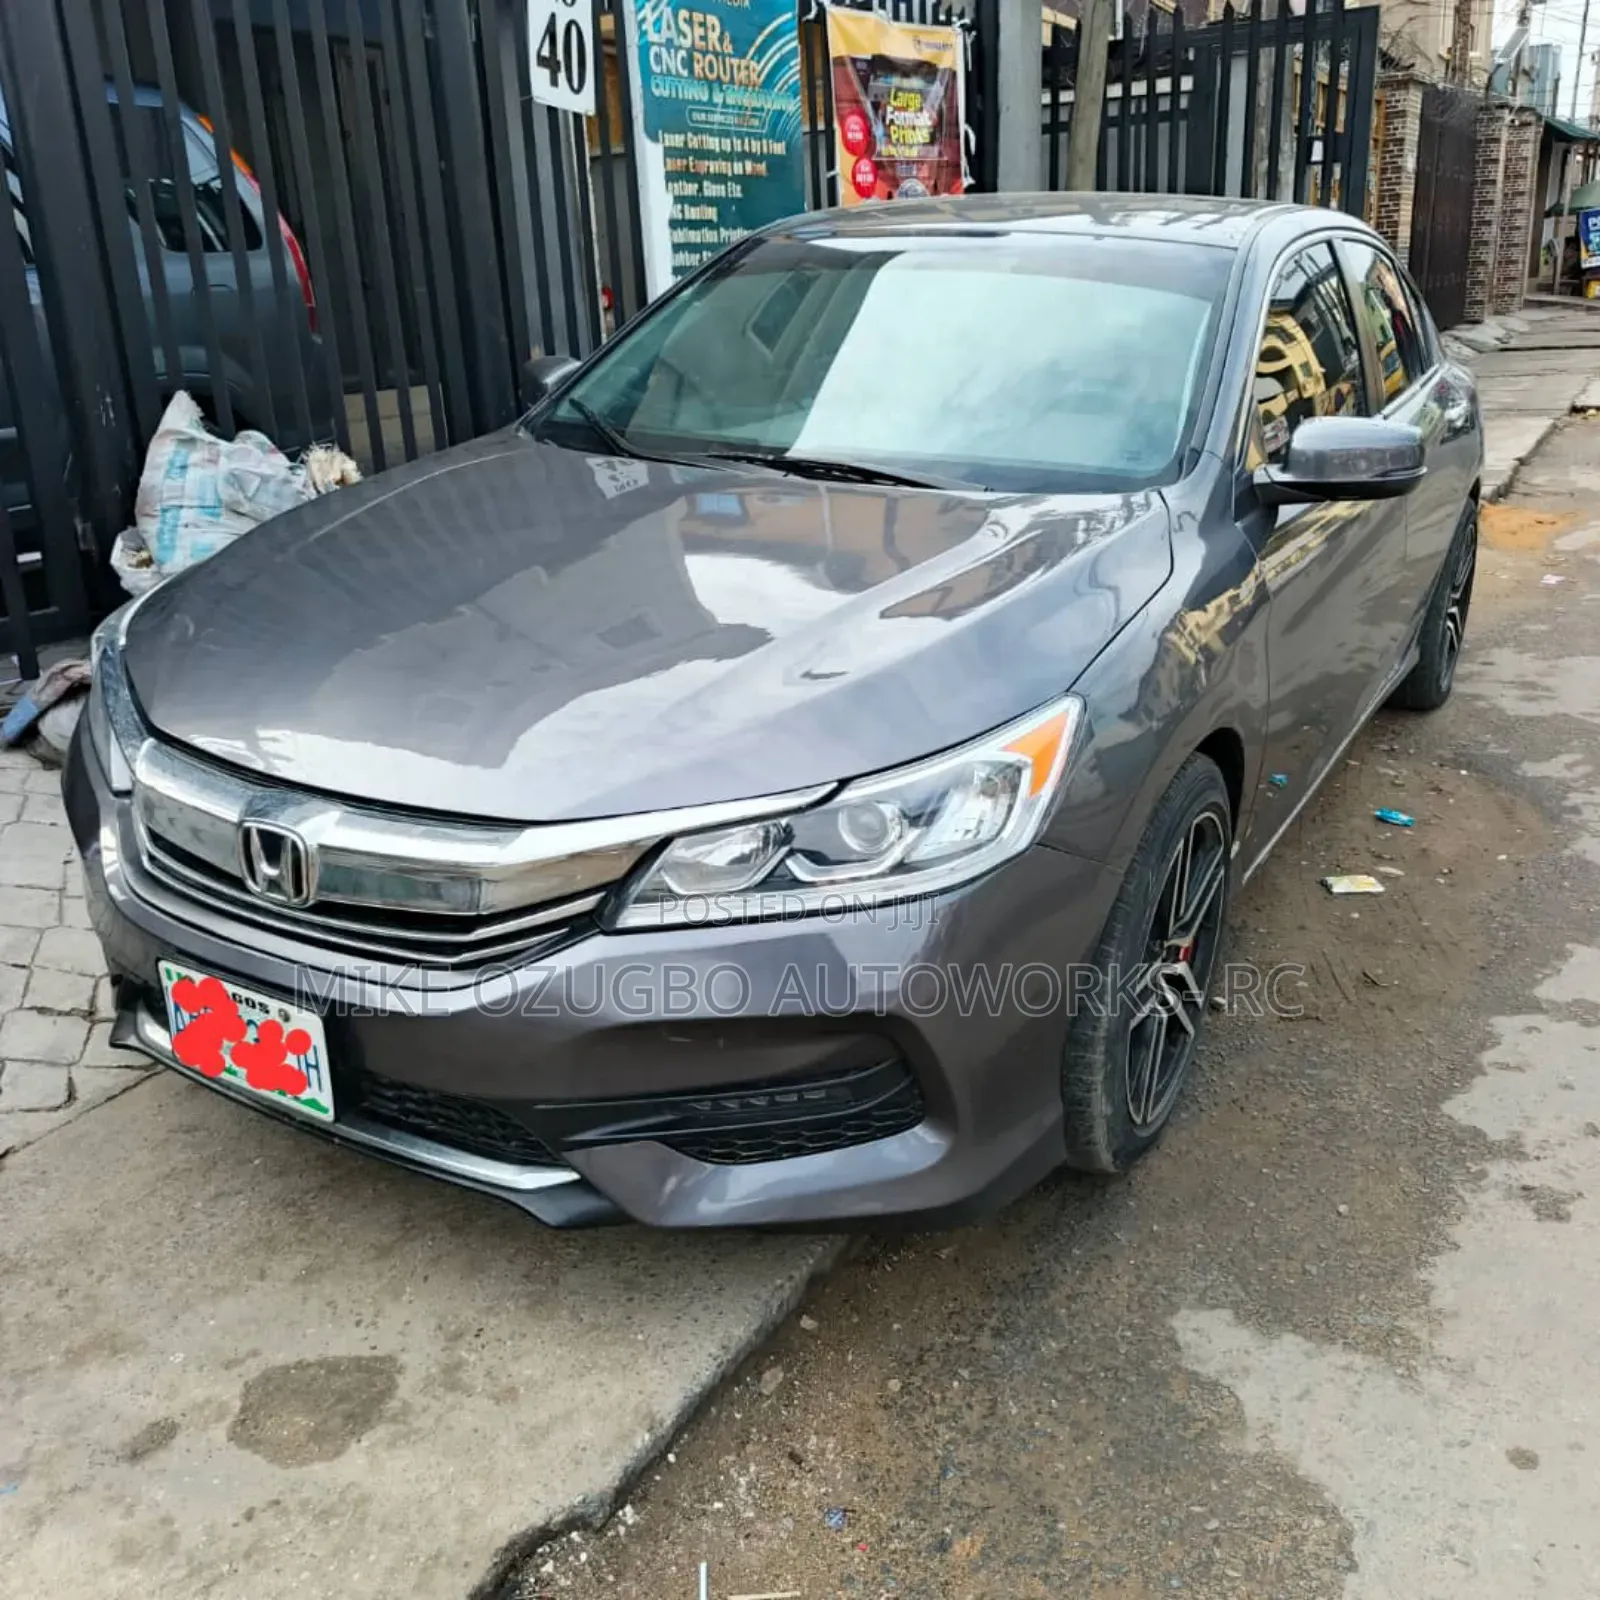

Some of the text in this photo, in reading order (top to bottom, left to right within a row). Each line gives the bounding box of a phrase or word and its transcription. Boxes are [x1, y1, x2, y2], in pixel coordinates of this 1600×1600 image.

[645, 4, 733, 55] LASER &
[536, 11, 587, 95] 40
[650, 45, 763, 87] CNC ROUTER
[651, 75, 709, 103] CUTTING
[889, 87, 921, 112] Large
[886, 105, 932, 126] Format
[658, 129, 686, 148] Laser
[687, 131, 720, 152] Cutting
[720, 136, 731, 152] up
[732, 135, 742, 153] to
[751, 136, 762, 156] by
[664, 157, 687, 172] aser
[688, 156, 732, 176] Engraving
[733, 160, 744, 175] on
[684, 203, 718, 223] Routing
[672, 227, 718, 244] ublimation
[673, 250, 700, 267] ubber
